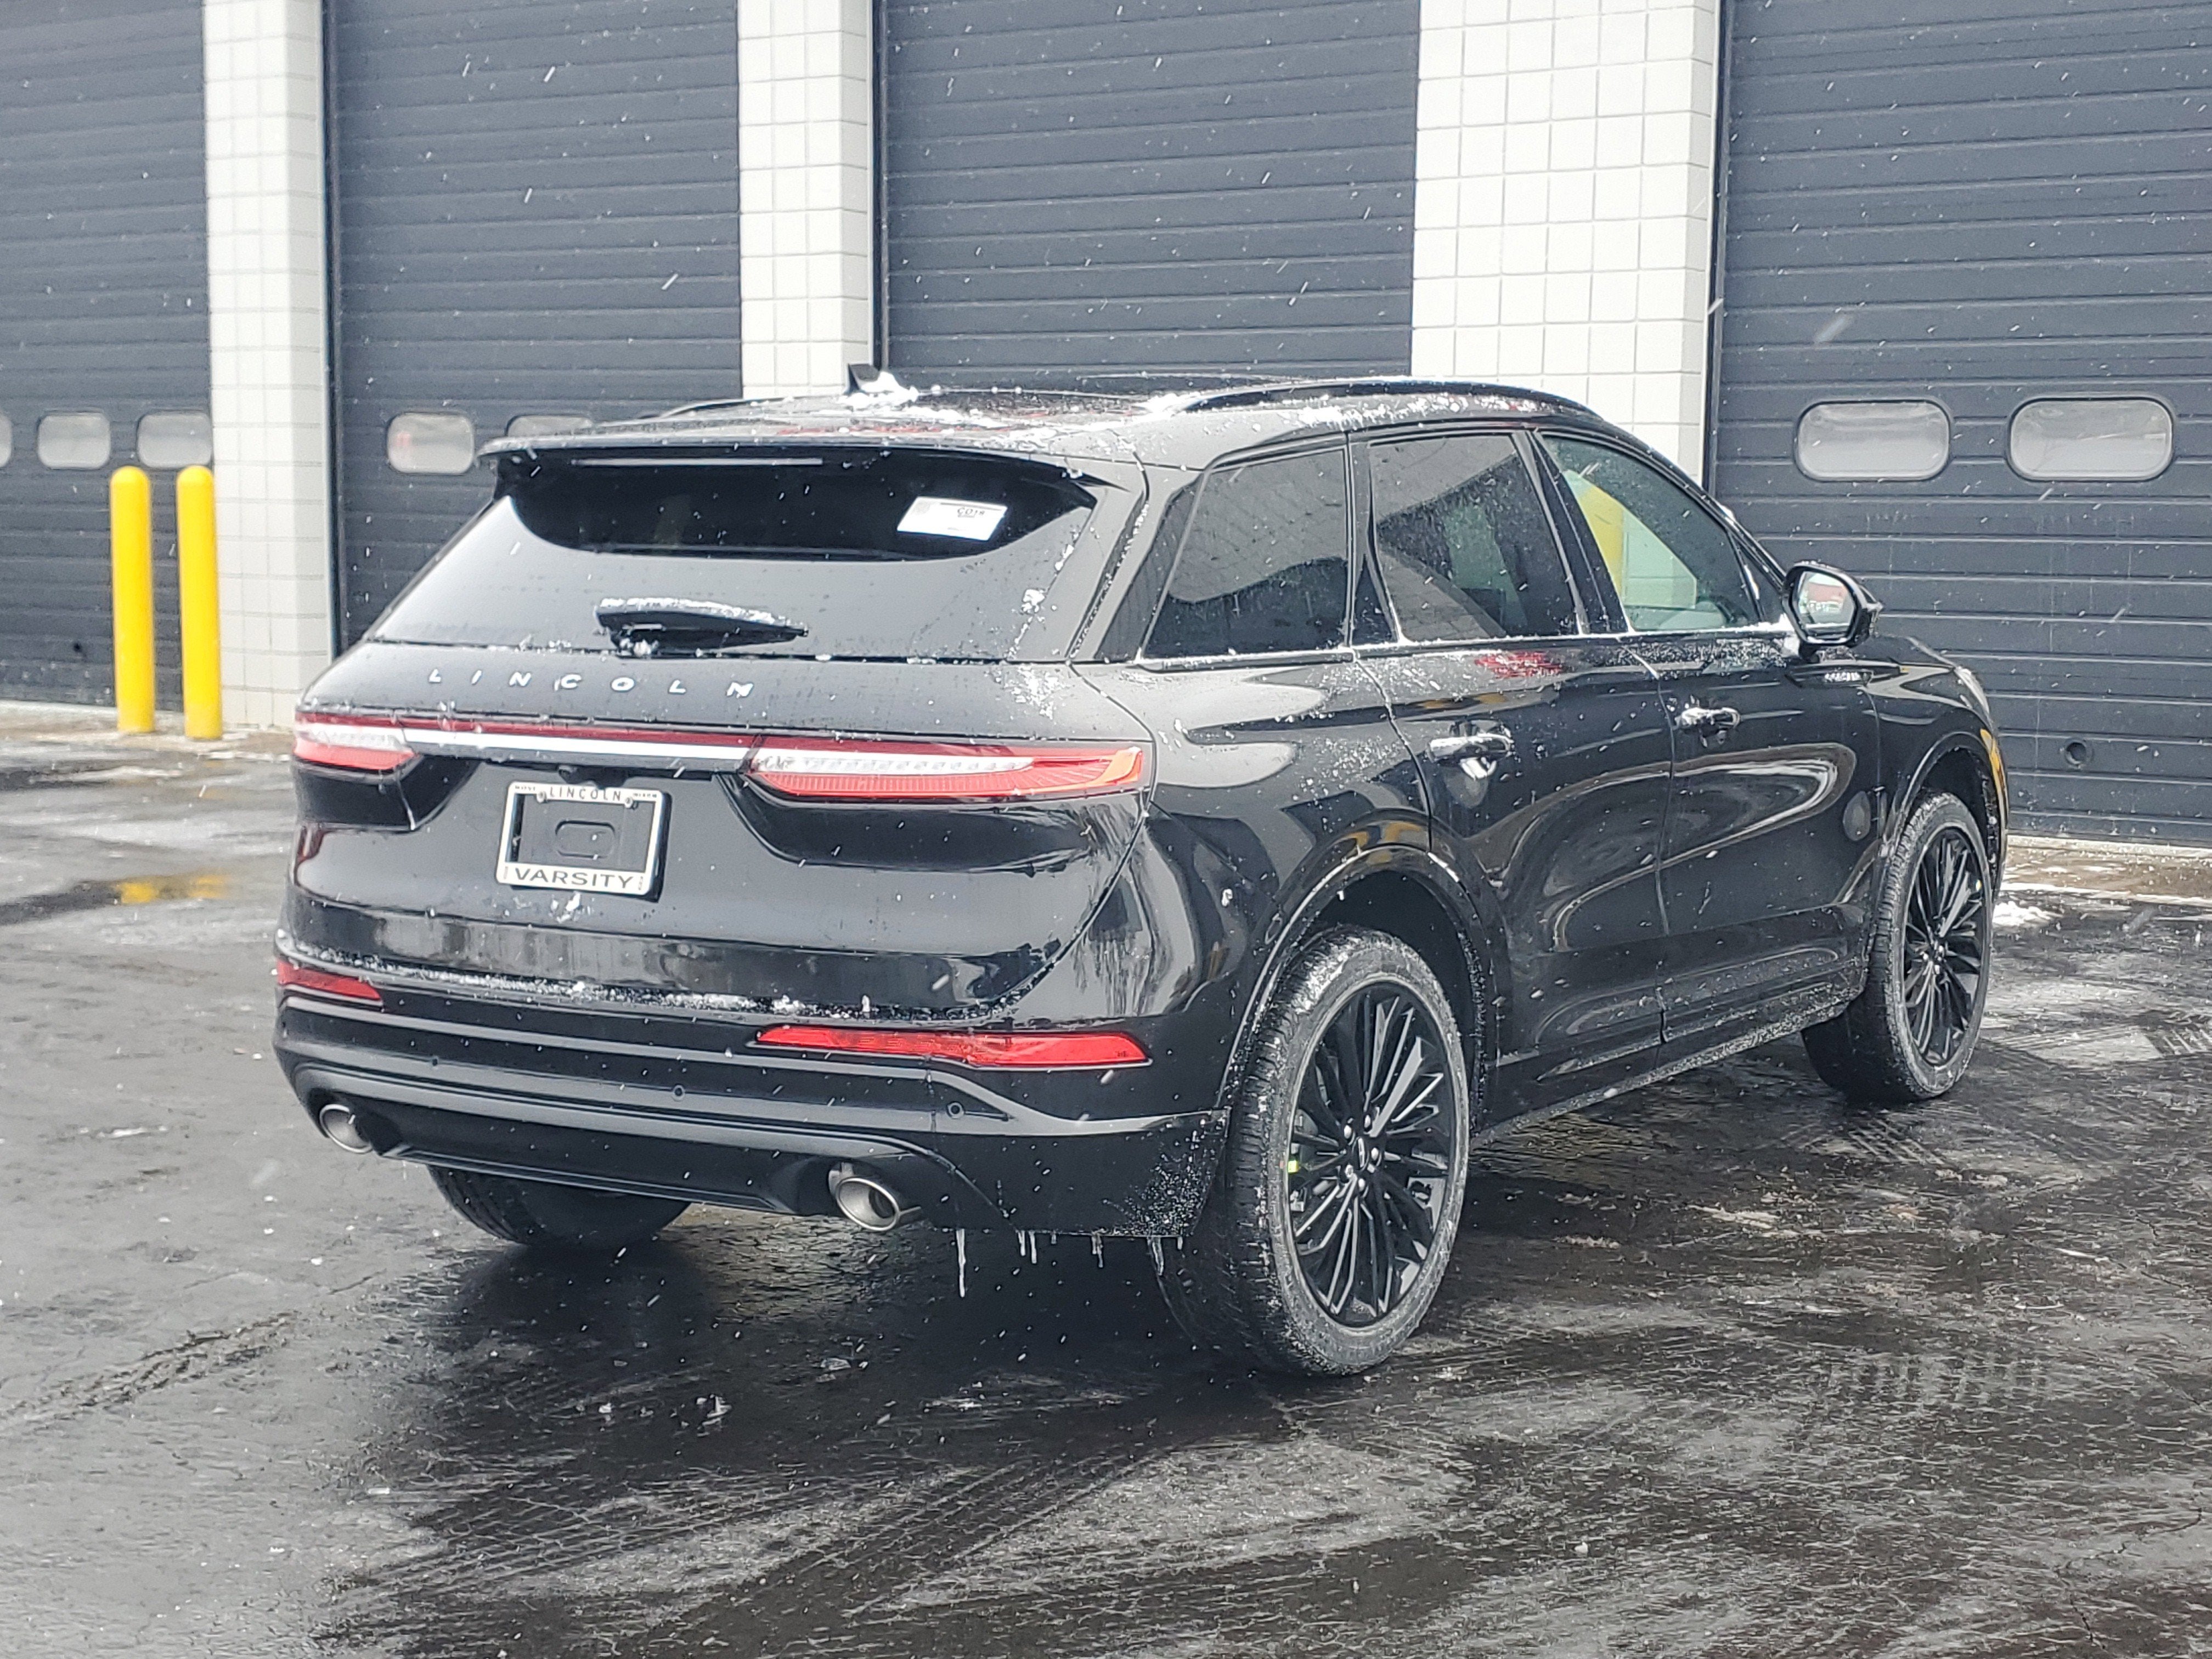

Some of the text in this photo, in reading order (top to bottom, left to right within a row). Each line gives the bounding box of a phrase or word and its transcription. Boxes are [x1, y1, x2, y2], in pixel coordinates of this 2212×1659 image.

[428, 669, 753, 697] LINCOLN
[549, 786, 622, 802] LINCOLN
[515, 867, 634, 889] VARSITY
